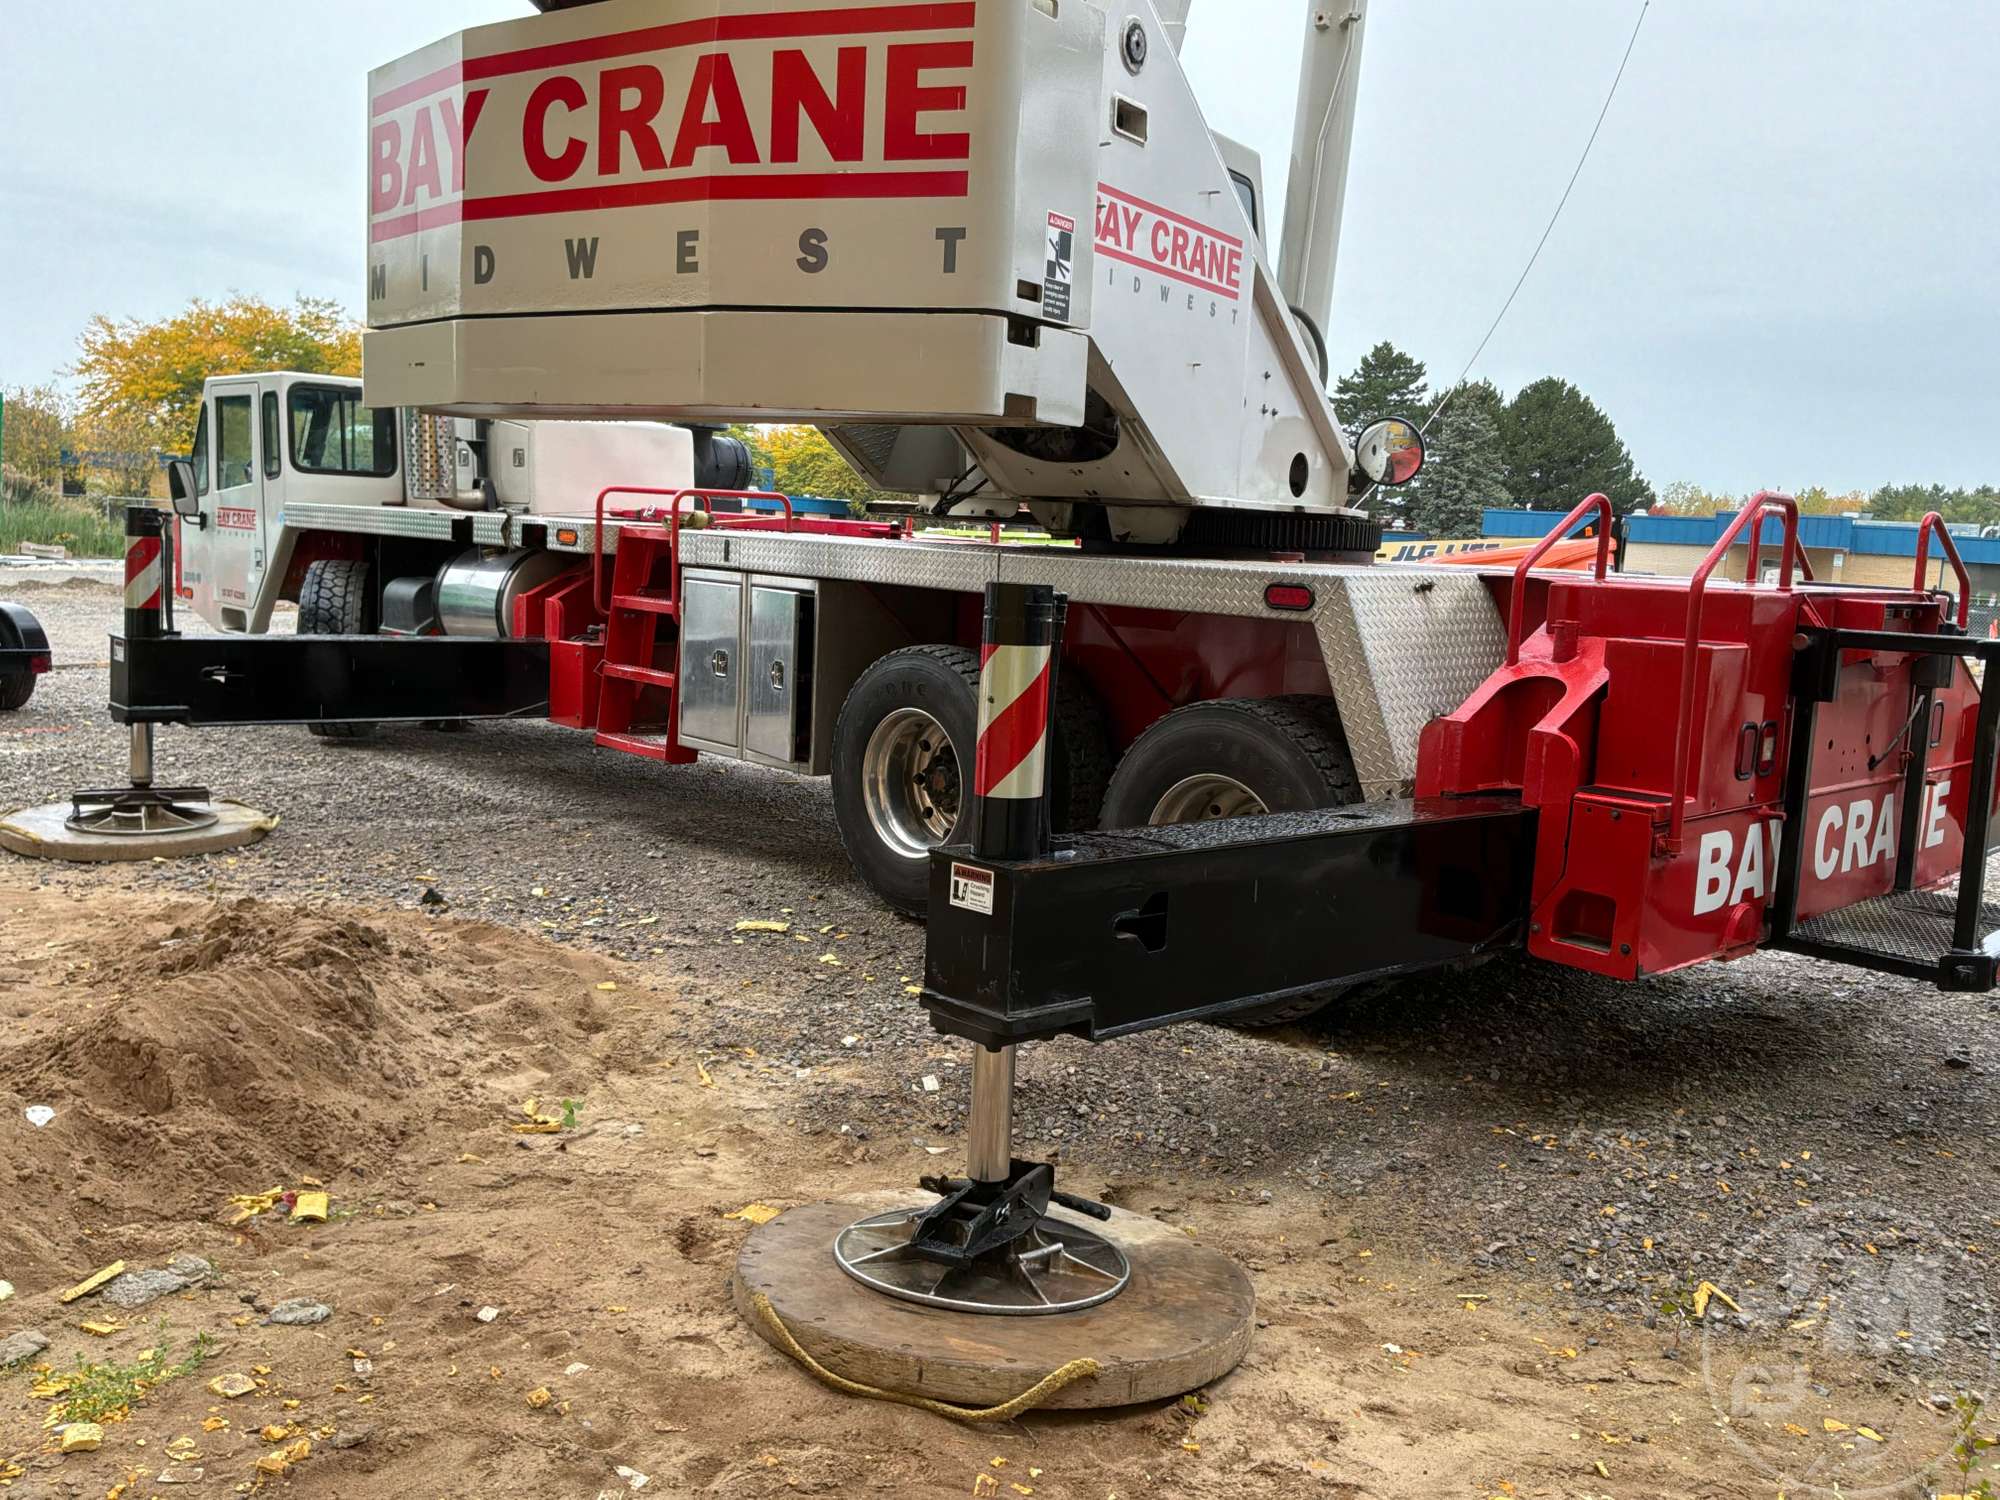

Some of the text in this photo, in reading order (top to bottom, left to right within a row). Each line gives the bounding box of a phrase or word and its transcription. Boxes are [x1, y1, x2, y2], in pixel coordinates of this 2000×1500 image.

[371, 41, 974, 216] BAY CRANE
[371, 227, 966, 301] MIDWEST
[1151, 220, 1242, 289] CRANE
[1109, 268, 1238, 325] IDWEST
[232, 511, 256, 526] CRANE
[1391, 544, 1438, 562] JLG
[1814, 780, 1951, 881] CRAE
